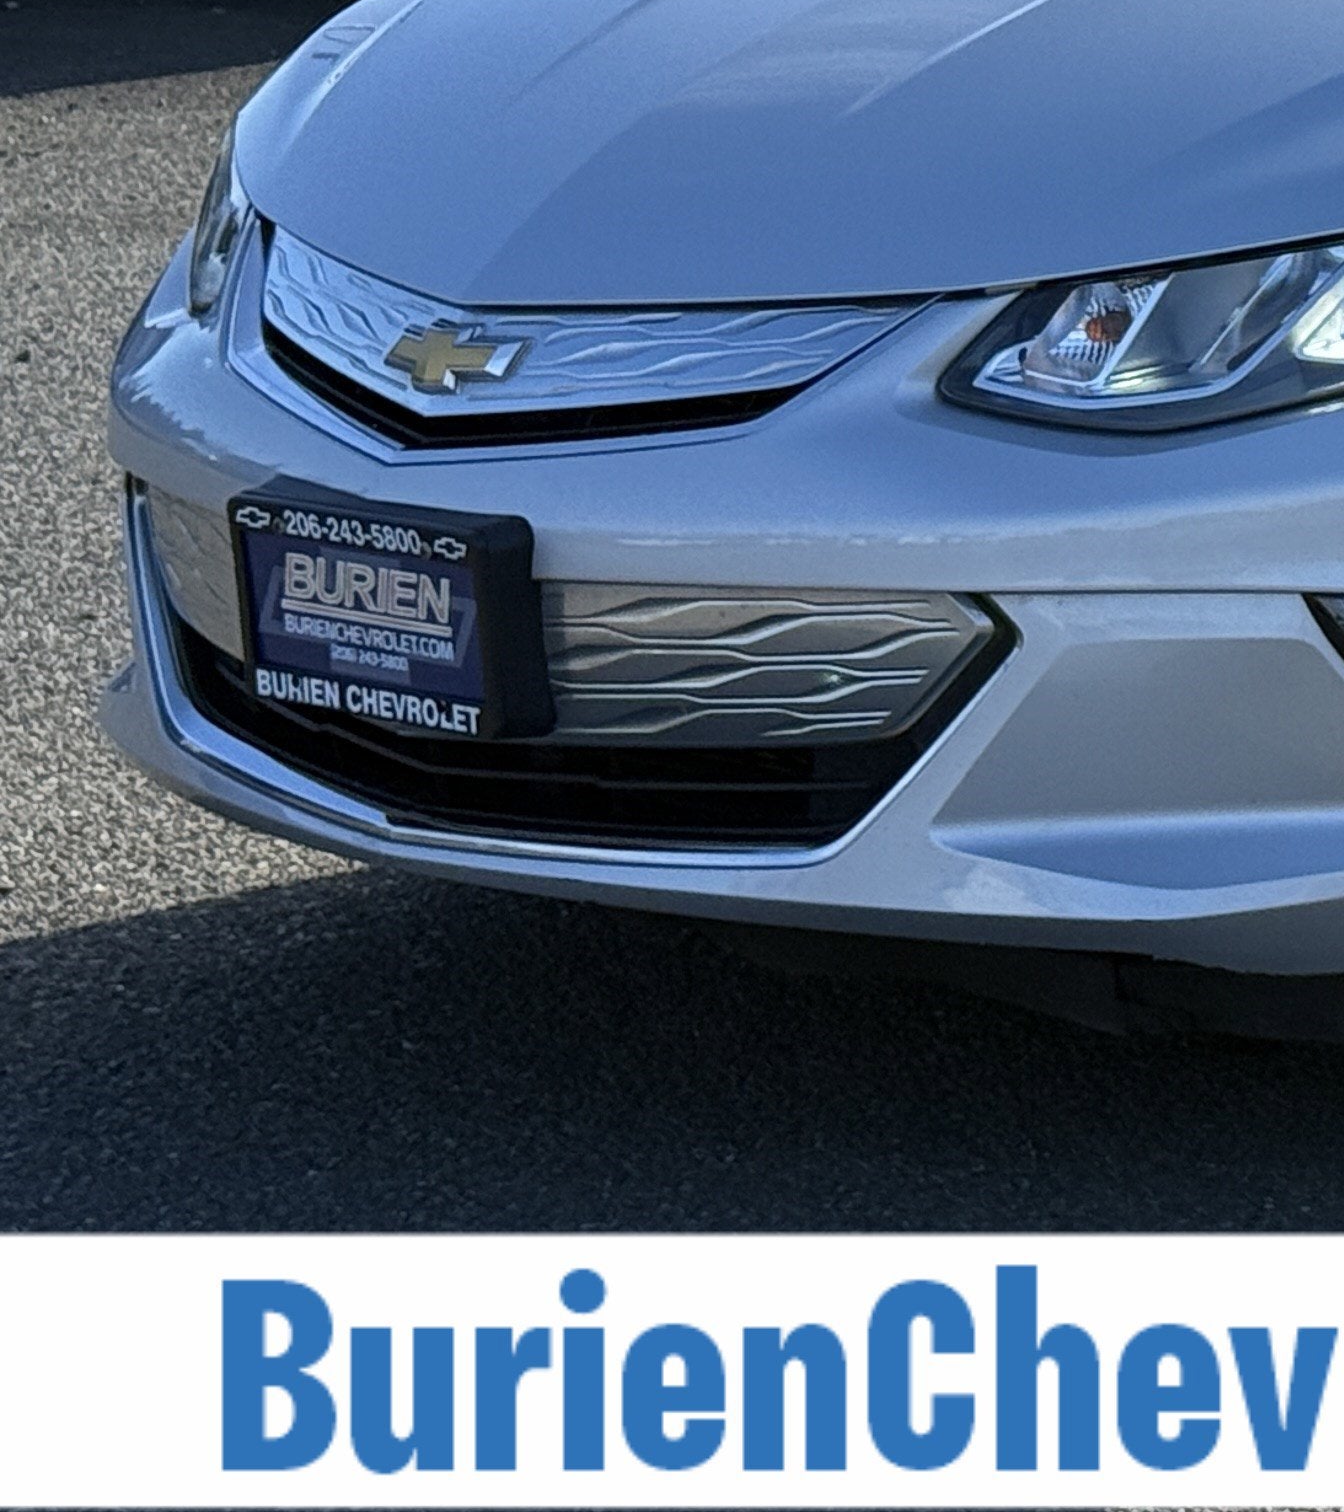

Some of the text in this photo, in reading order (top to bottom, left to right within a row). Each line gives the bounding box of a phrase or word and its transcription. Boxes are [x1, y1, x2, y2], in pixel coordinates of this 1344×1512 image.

[283, 509, 421, 555] 206-243-5800
[284, 551, 451, 624] BURIEN
[284, 612, 455, 661] BURIENCHEVROLET.COM
[256, 668, 482, 736] BURIEN CHEVROLET
